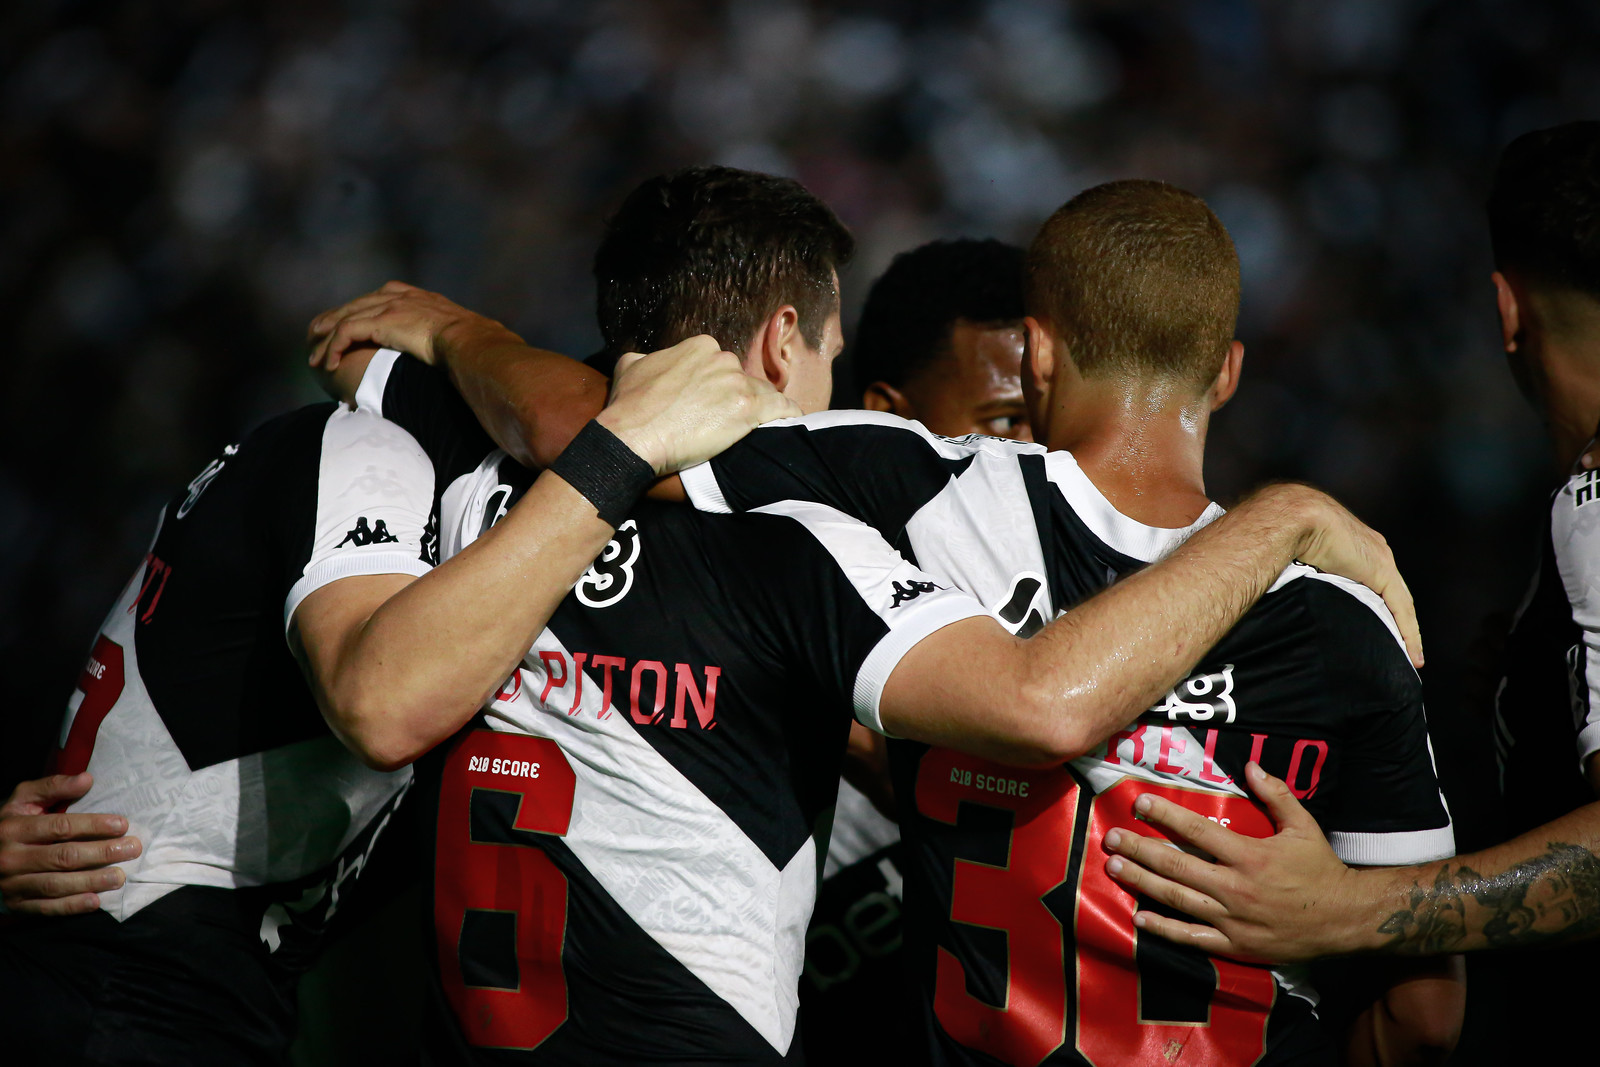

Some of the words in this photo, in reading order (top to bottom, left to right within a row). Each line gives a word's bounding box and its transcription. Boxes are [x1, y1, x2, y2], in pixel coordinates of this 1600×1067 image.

[538, 650, 722, 731] PITON
[491, 757, 541, 779] SCORE
[975, 773, 1030, 798] SCORE
[1088, 718, 1330, 801] RELLO
[433, 728, 577, 1052] 6
